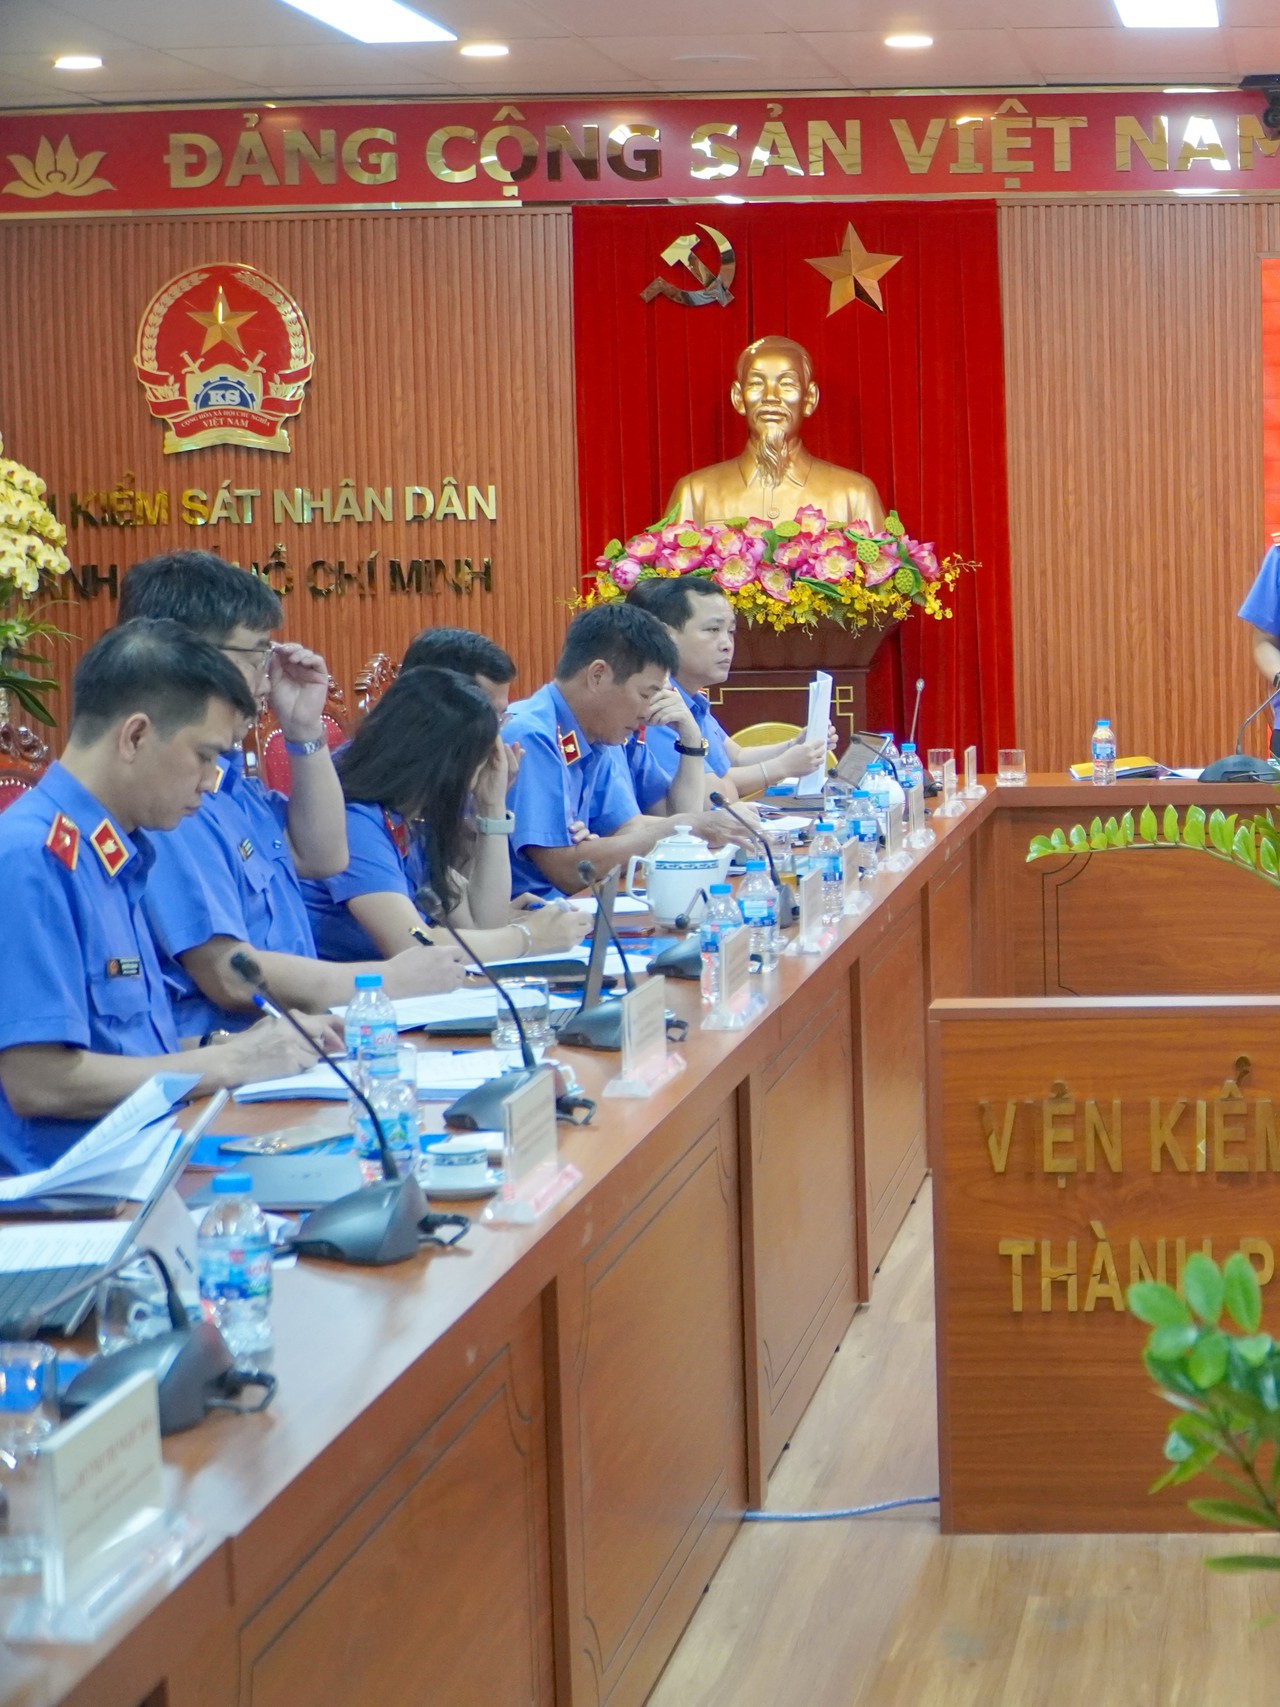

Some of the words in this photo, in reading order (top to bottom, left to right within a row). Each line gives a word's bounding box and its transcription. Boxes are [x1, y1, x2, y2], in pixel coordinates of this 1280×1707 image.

[163, 113, 398, 188] ĐẢNG
[425, 106, 662, 198] CỘNG
[691, 103, 862, 181] SẢN
[890, 98, 1088, 188] VIỆT
[202, 416, 225, 428] VIỆT
[228, 417, 249, 428] NAM
[208, 389, 241, 405] KS
[70, 471, 169, 527] KIỂM
[181, 479, 261, 525] SÁT
[273, 478, 394, 524] NHÂN
[406, 476, 497, 522] DÂN
[307, 550, 380, 596] CHÍ
[390, 557, 493, 594] MINH
[978, 1080, 1123, 1188] VIỆN
